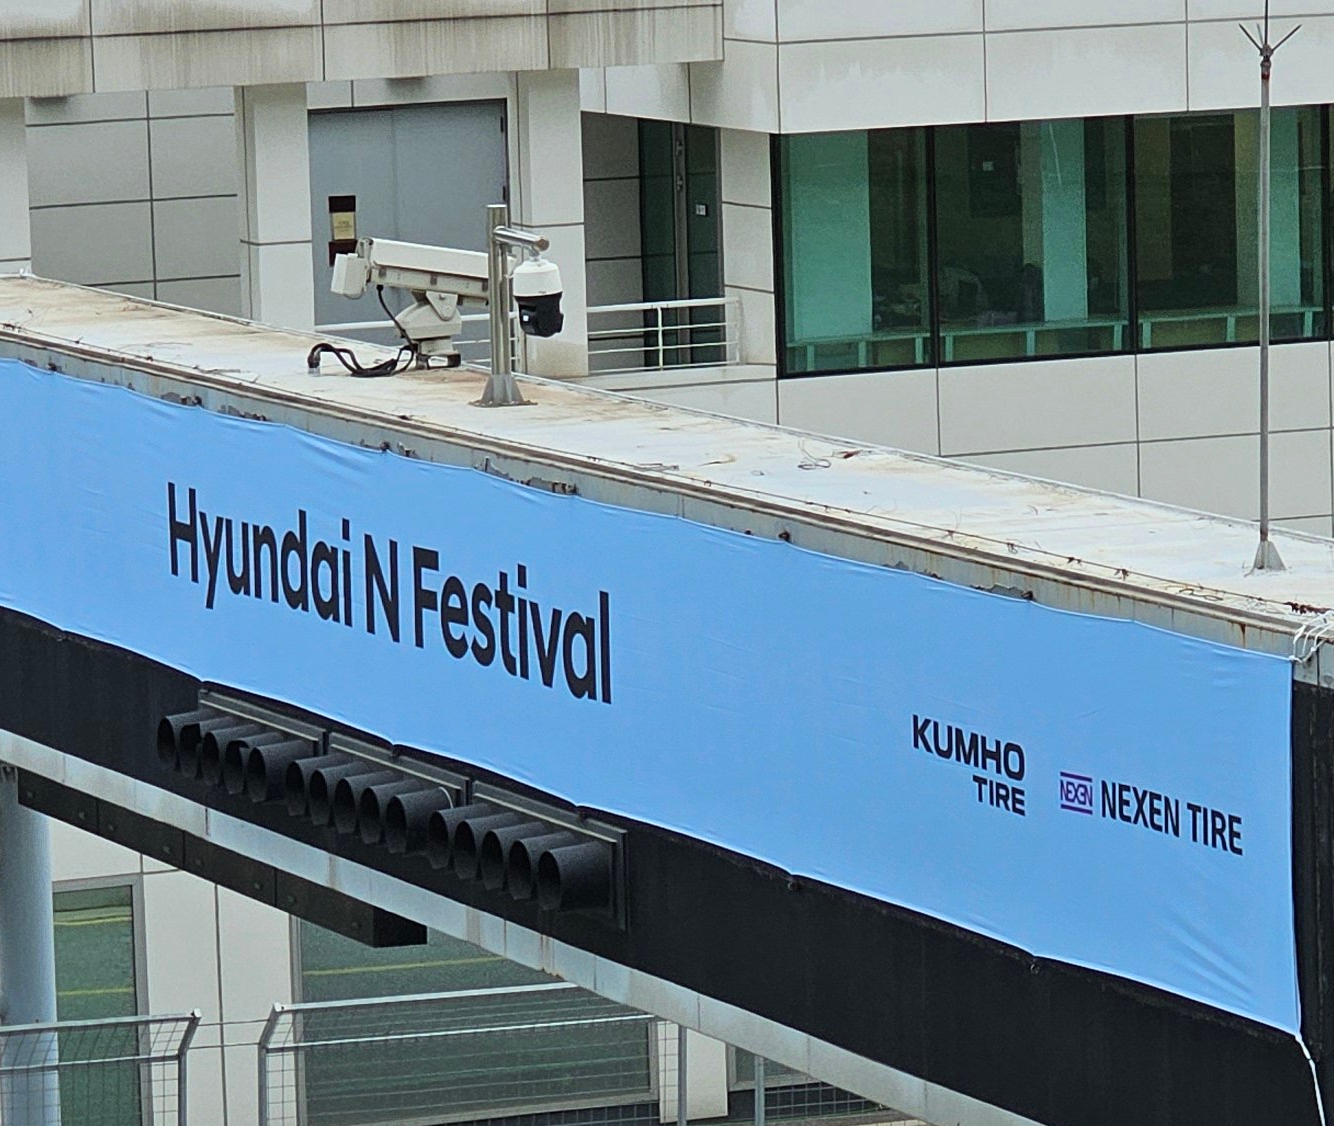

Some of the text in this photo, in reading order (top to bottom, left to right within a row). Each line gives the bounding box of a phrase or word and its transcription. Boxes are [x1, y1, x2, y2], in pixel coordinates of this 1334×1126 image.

[167, 482, 611, 704] Hyundai N Festival
[912, 714, 1025, 781] KUMHO
[972, 774, 1026, 816] TIRE
[1101, 779, 1243, 856] NEXEN TIRE
